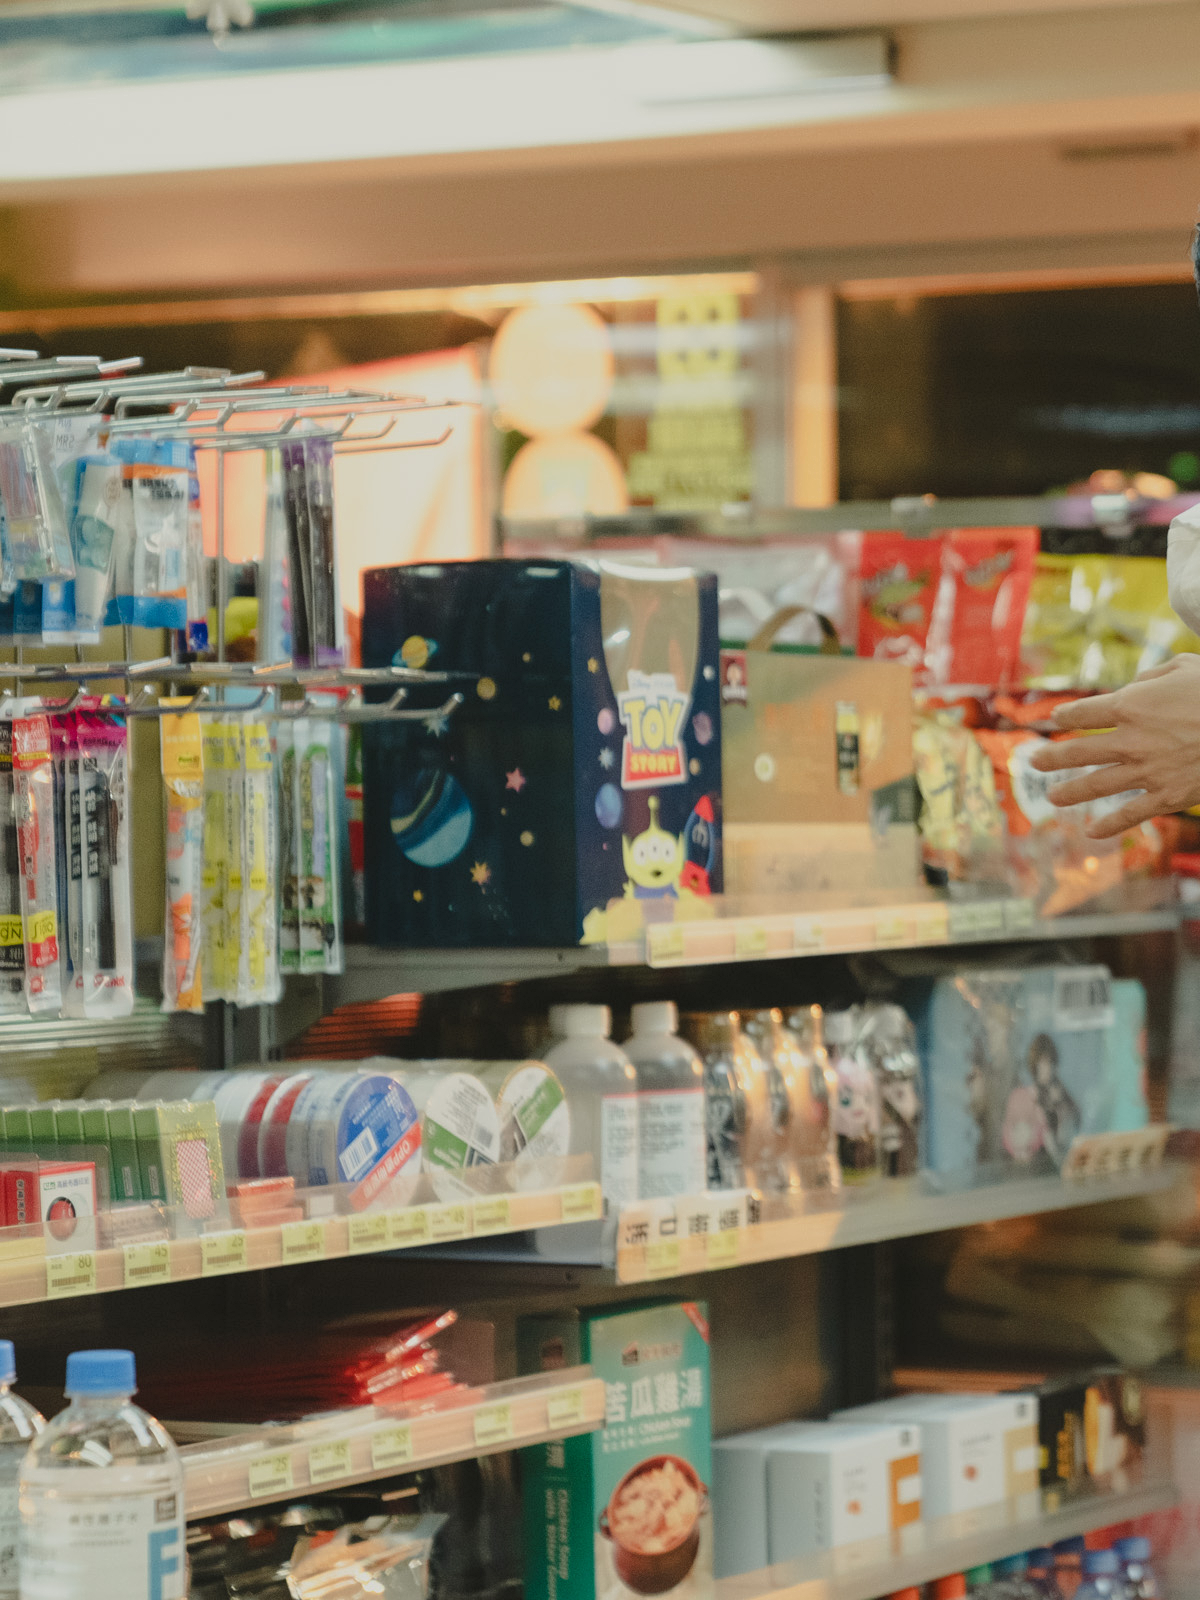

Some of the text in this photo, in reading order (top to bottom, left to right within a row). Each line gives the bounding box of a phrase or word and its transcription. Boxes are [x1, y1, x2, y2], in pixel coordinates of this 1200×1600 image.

[623, 697, 684, 752] TOY
[630, 755, 677, 774] STORY
[78, 1254, 92, 1269] 80
[275, 1457, 288, 1471] 25
[148, 1527, 179, 1600] F
